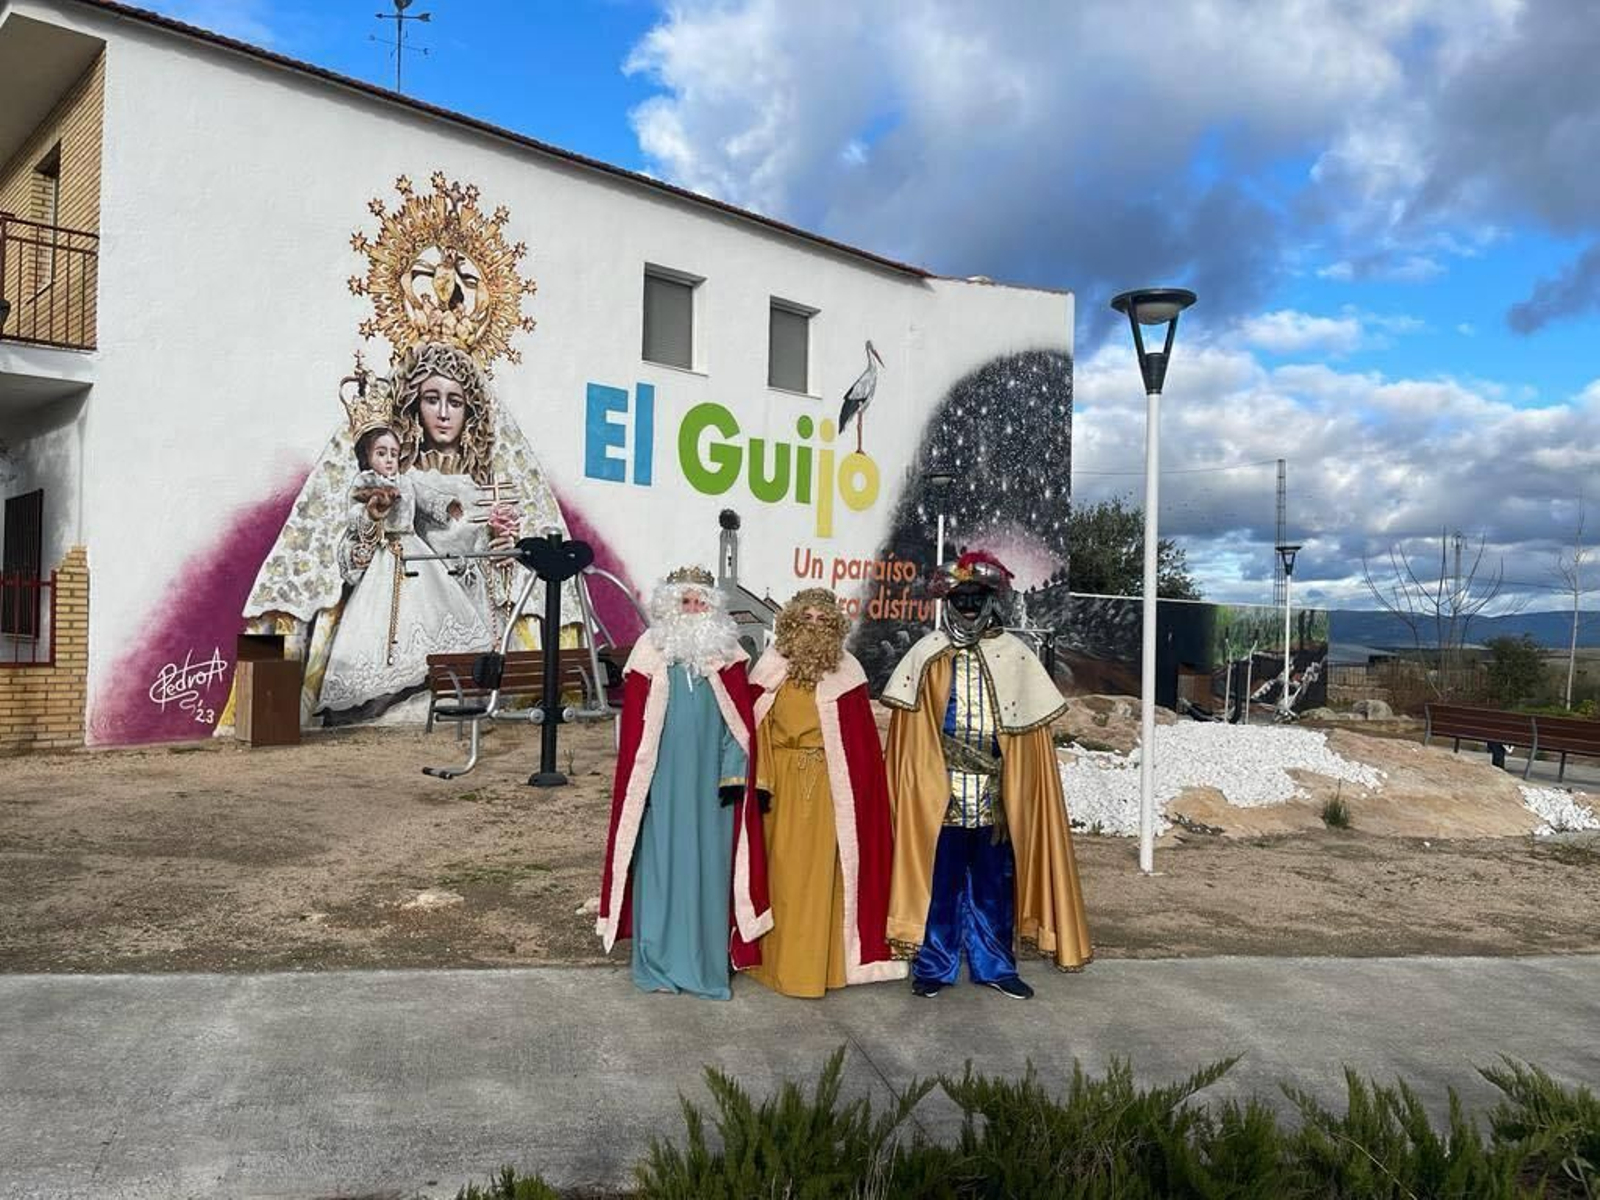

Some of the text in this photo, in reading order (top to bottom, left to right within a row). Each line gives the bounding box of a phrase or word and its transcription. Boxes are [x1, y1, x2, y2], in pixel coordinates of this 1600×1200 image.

[585, 382, 880, 539] El Guijo
[794, 547, 916, 590] Un paraíso
[869, 584, 936, 622] disfru
